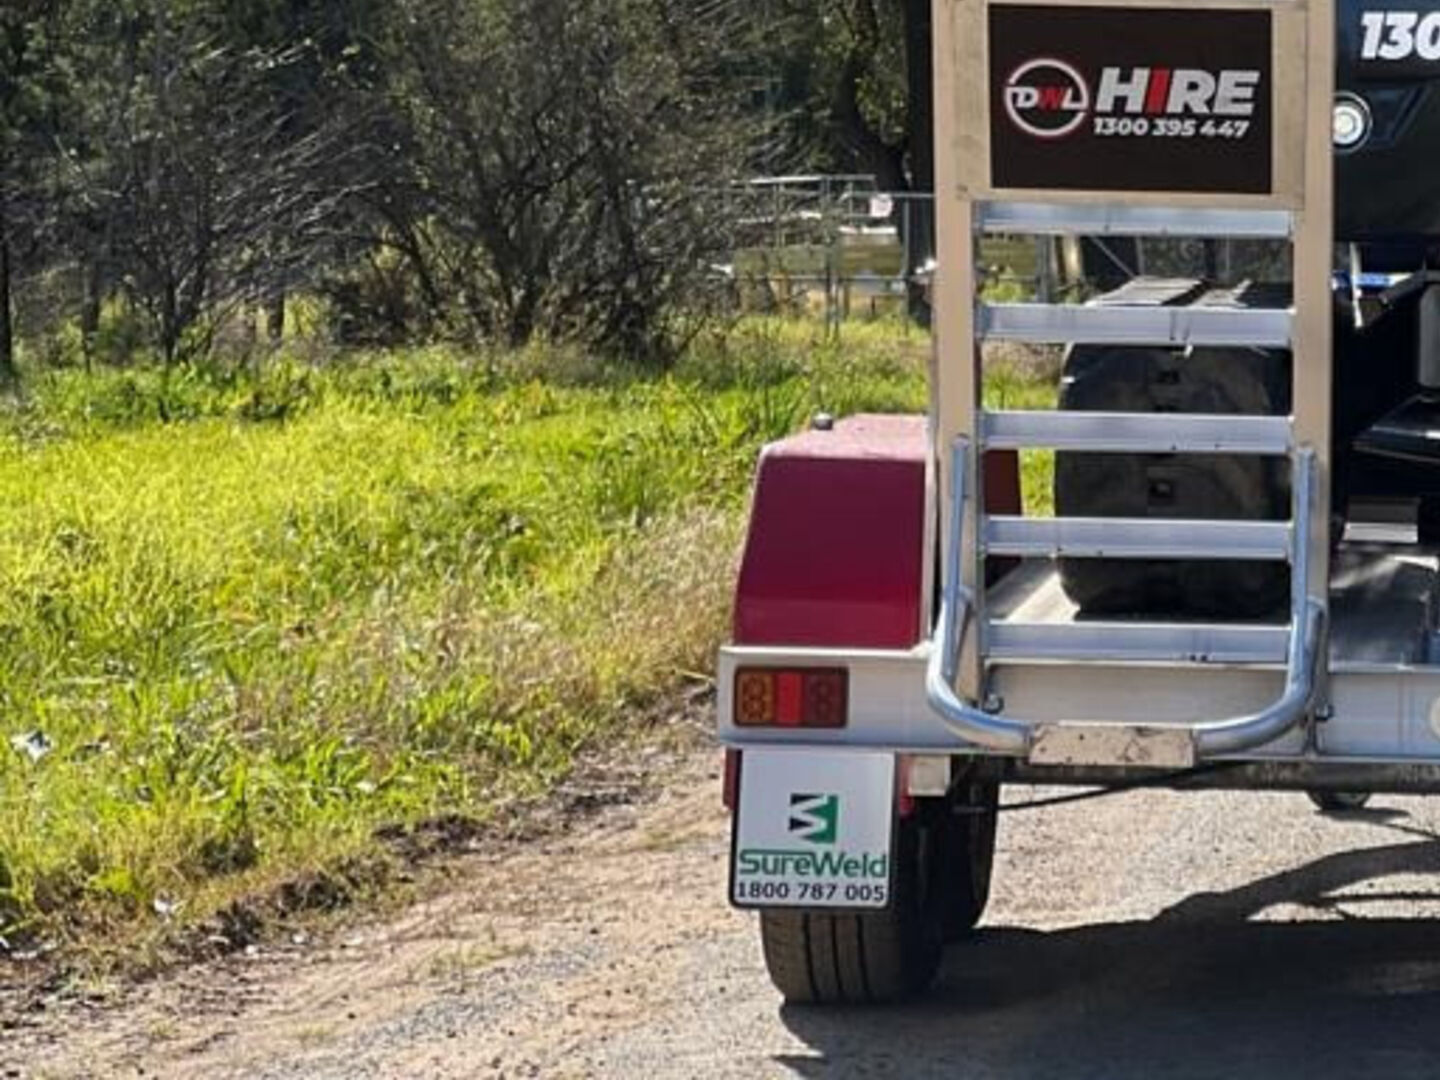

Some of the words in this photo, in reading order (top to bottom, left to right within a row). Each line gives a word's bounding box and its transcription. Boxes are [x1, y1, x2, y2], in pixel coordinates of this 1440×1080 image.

[1096, 67, 1260, 115] HIRE
[1095, 117, 1149, 136] 1300
[1152, 118, 1196, 138] 395
[1199, 120, 1249, 139] 447
[738, 849, 887, 878] SureWeld
[737, 882, 790, 899] 1800
[797, 883, 836, 900] 787
[845, 884, 885, 901] 005
